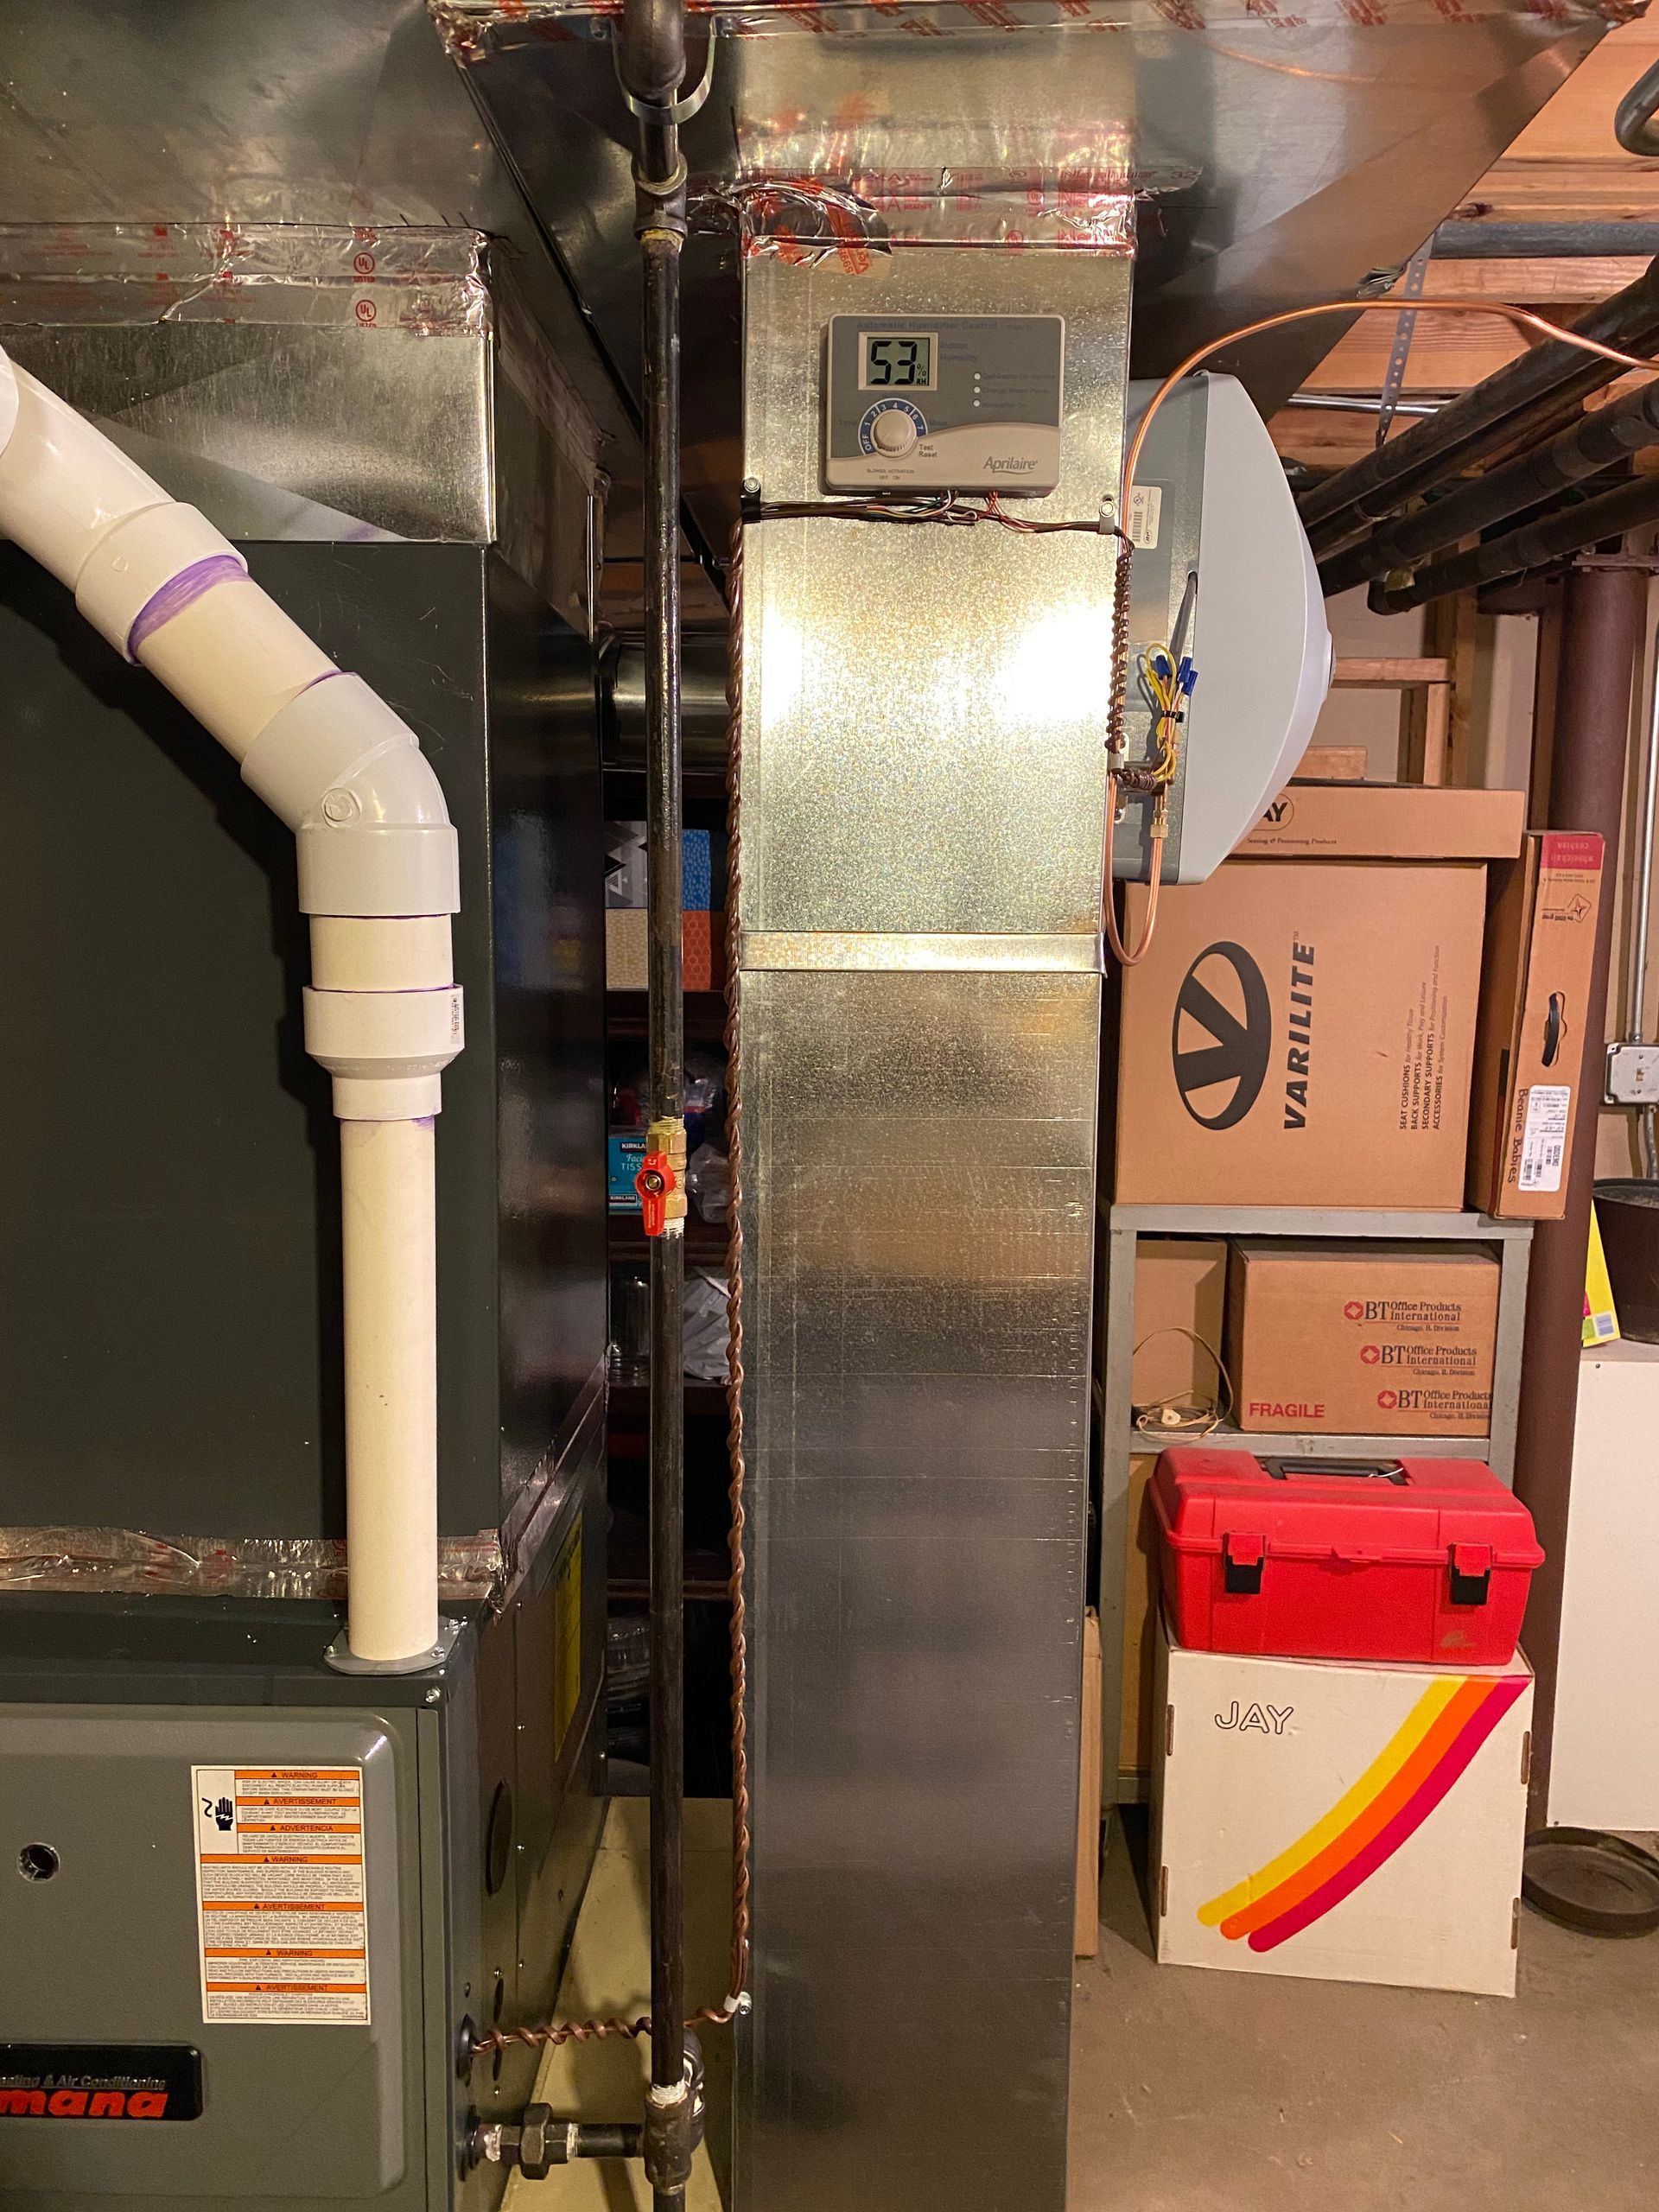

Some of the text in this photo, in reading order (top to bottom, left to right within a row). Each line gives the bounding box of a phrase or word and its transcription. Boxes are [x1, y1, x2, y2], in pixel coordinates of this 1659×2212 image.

[870, 340, 918, 385] 53
[862, 434, 872, 451] OFF
[983, 456, 1036, 473] Aprilaire
[1262, 802, 1288, 822] AY
[1429, 988, 1439, 1021] Positioning
[1283, 942, 1315, 1129] VARILITE
[1426, 1033, 1434, 1077] SUPPORTS
[1402, 1065, 1410, 1108] CUSHIONS
[1413, 1062, 1422, 1106] SUPPORTS
[1422, 1080, 1432, 1130] SECONDARY
[1433, 1076, 1443, 1130] ACCESSORIES
[1508, 1089, 1529, 1183] Beanie Babies
[1365, 1301, 1390, 1320] BT
[1390, 1301, 1461, 1312] Office Products
[1390, 1312, 1460, 1321] International
[1382, 1345, 1406, 1364] BT
[1407, 1345, 1477, 1356] Office Products
[1407, 1356, 1476, 1365] International
[1398, 1389, 1422, 1408] BT
[1424, 1390, 1450, 1399] Office
[1249, 1402, 1325, 1418] FRAGILE
[1214, 1700, 1294, 1735] JAY
[57, 2075, 79, 2088] Air
[80, 2075, 166, 2091] Conditioning
[0, 2089, 168, 2118] mana
